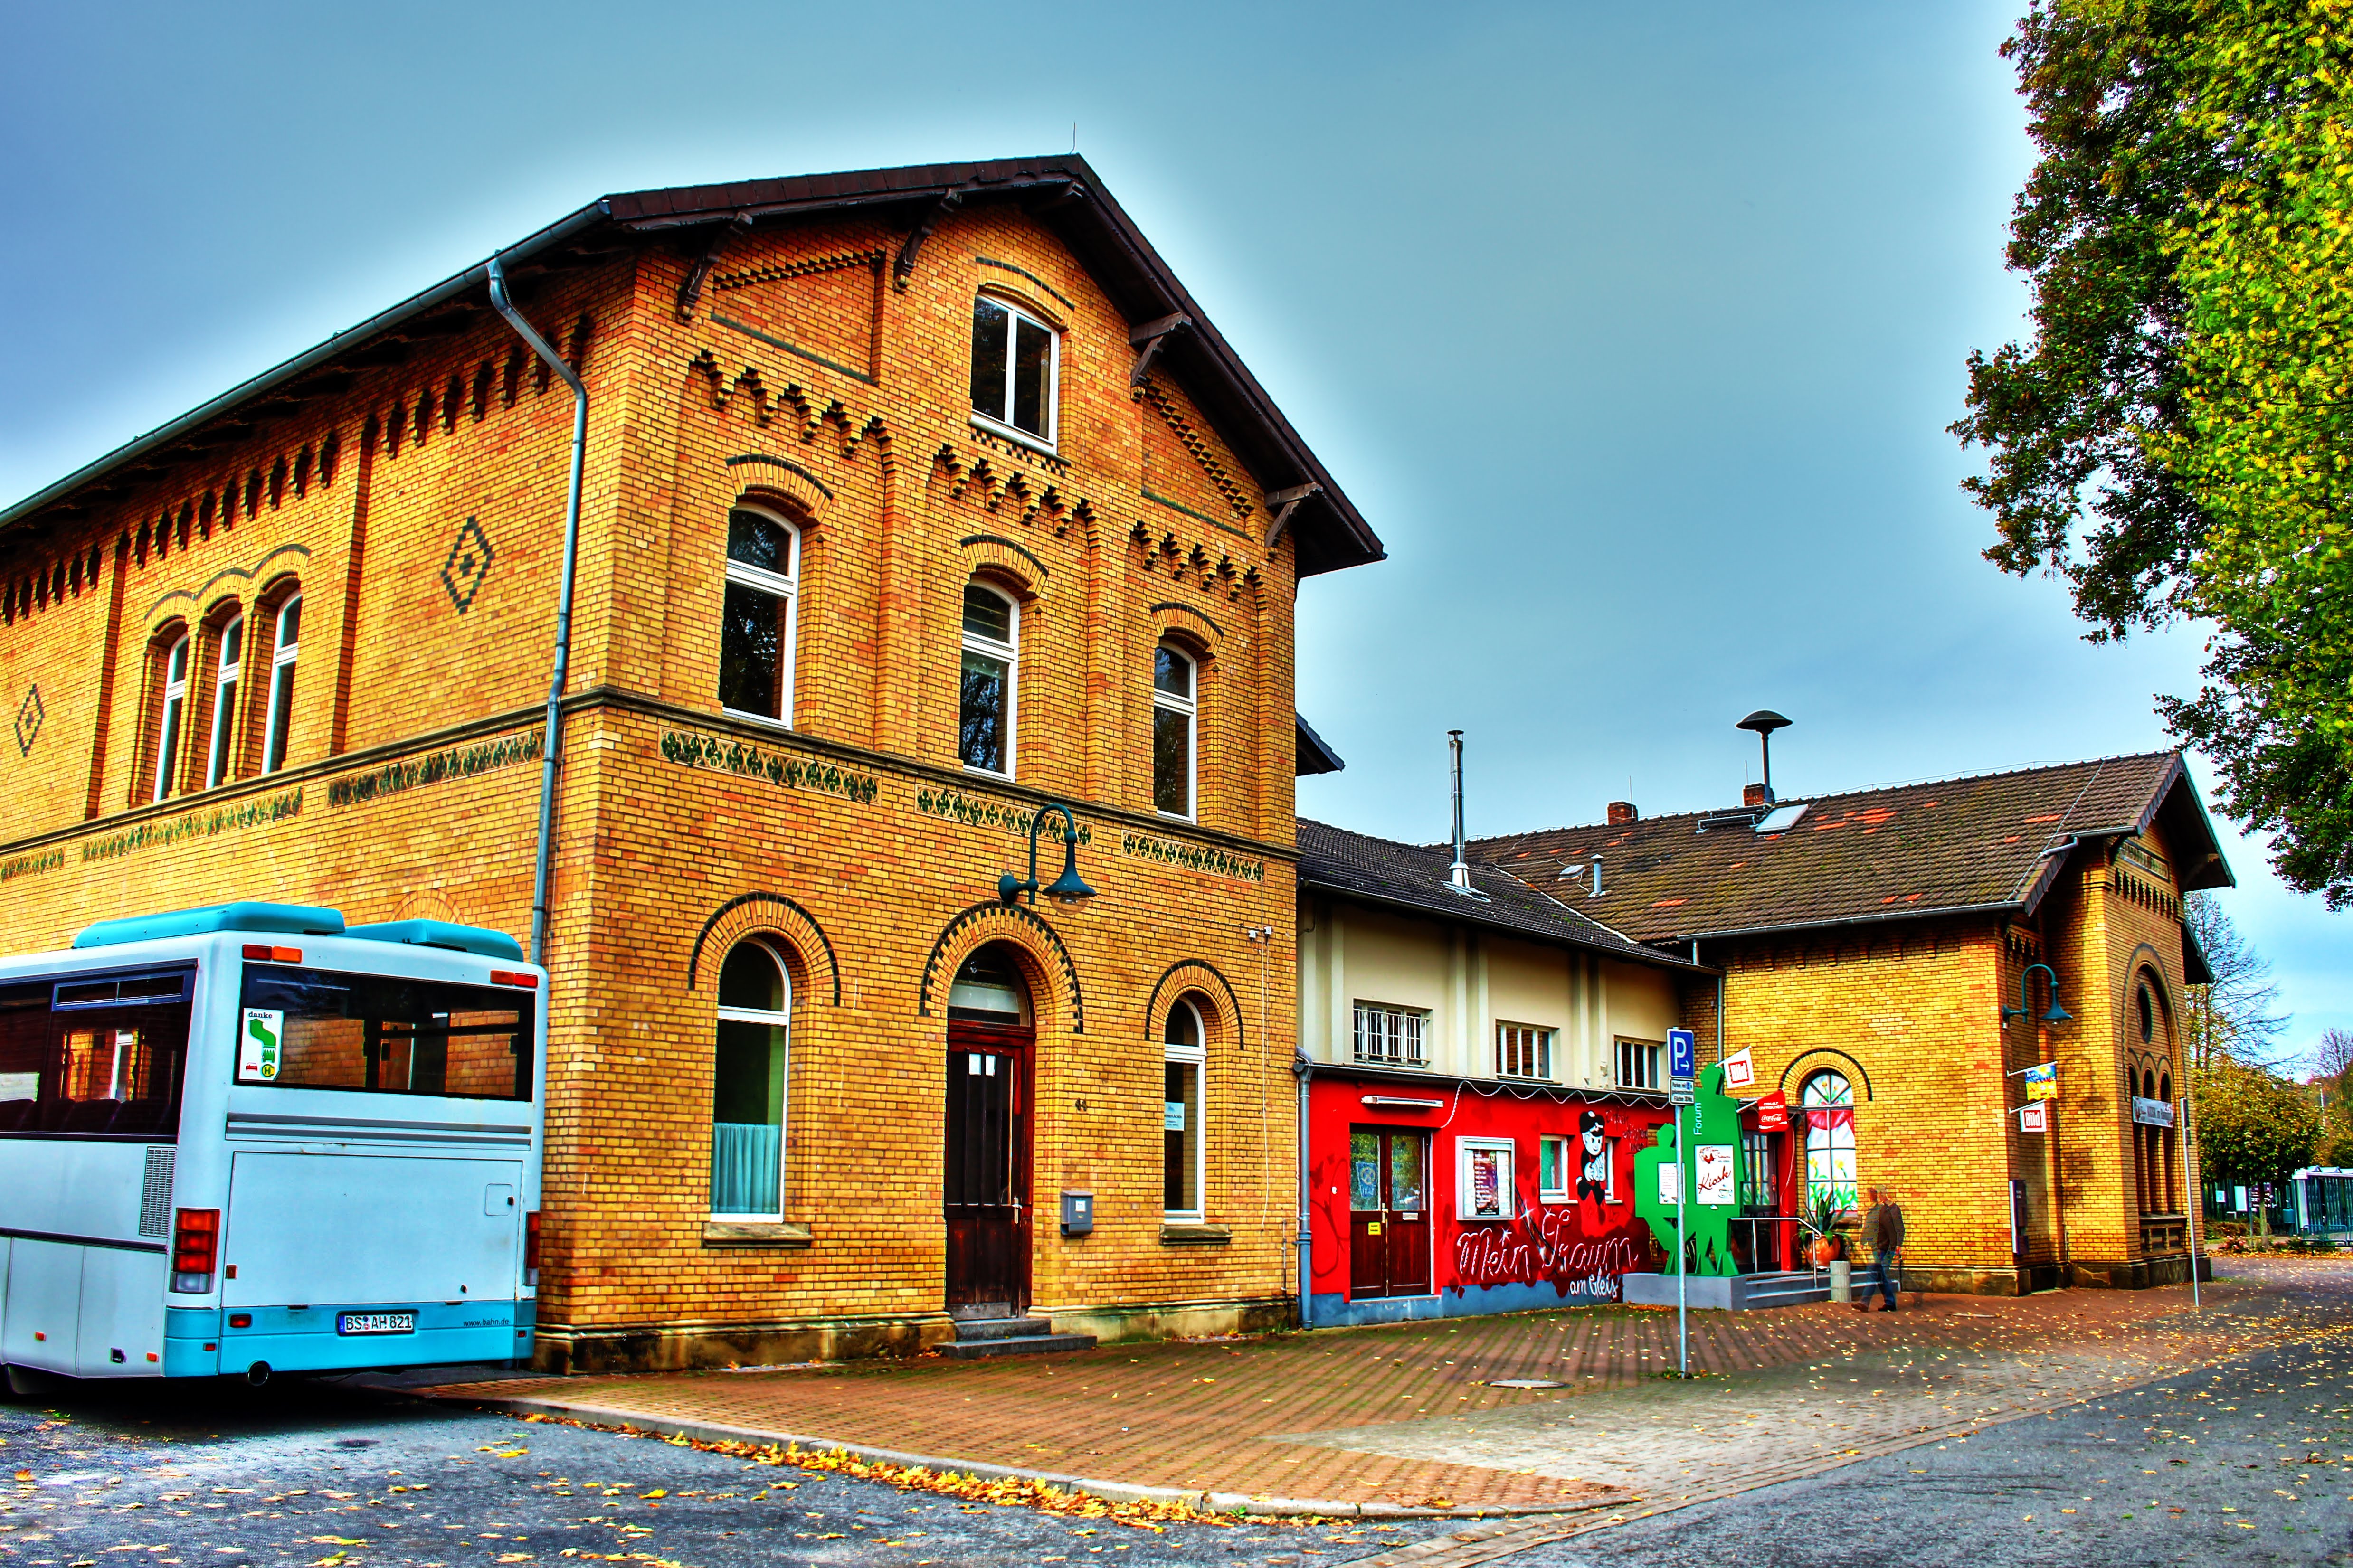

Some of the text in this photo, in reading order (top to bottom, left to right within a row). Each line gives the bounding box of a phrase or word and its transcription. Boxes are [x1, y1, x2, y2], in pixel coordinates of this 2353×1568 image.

[1673, 1037, 1686, 1071] P
[1729, 1062, 1748, 1081] Bild
[1074, 1097, 1087, 1112] 44
[1693, 1102, 1702, 1135] Forum
[1761, 1114, 1782, 1122] Coca-Cola
[2025, 1112, 2041, 1126] Bild
[1698, 1165, 1731, 1194] Kiosk
[1457, 1209, 1639, 1281] Mein Traum
[1570, 1266, 1619, 1299] am Gleis
[346, 1315, 412, 1330] BS AH 821
[463, 1318, 510, 1326] www.bahn.de
